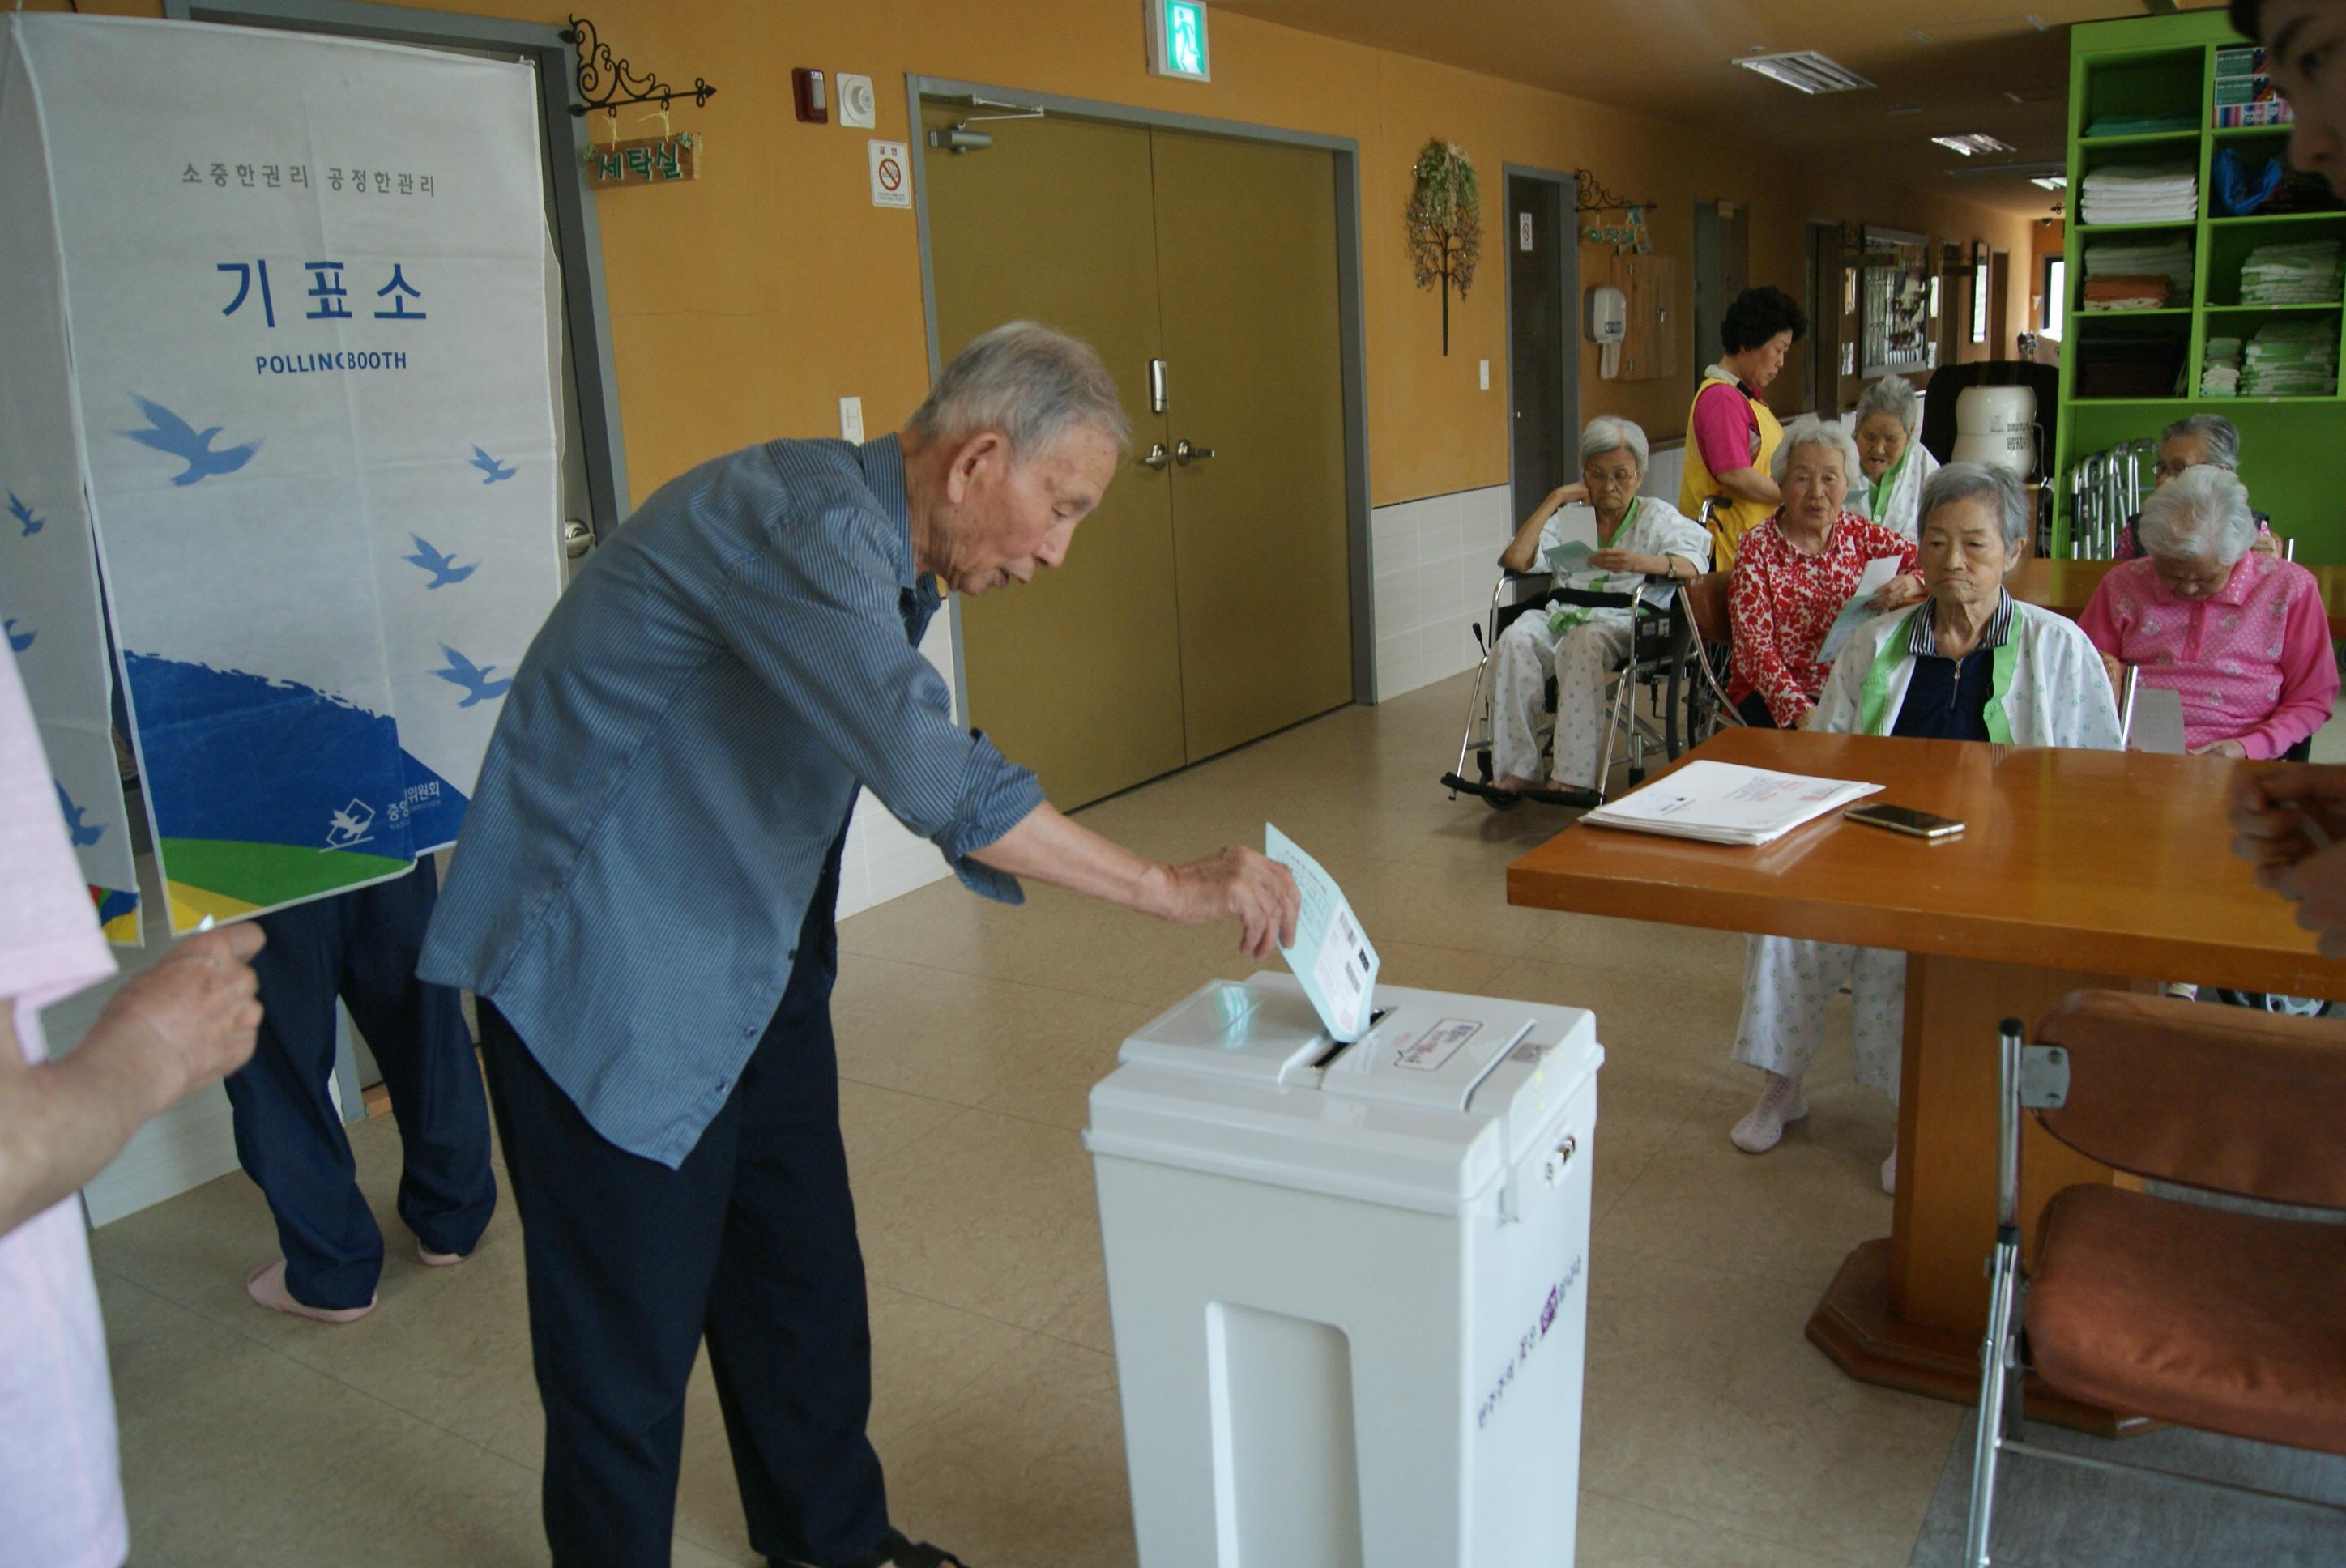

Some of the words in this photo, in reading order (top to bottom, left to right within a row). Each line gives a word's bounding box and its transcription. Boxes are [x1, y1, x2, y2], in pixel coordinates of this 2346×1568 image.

[181, 162, 309, 189] 소중한권리
[327, 167, 434, 197] 공정한관리
[599, 141, 683, 181] 세탁실
[216, 259, 428, 328] 기표소
[347, 352, 407, 370] BOOTH
